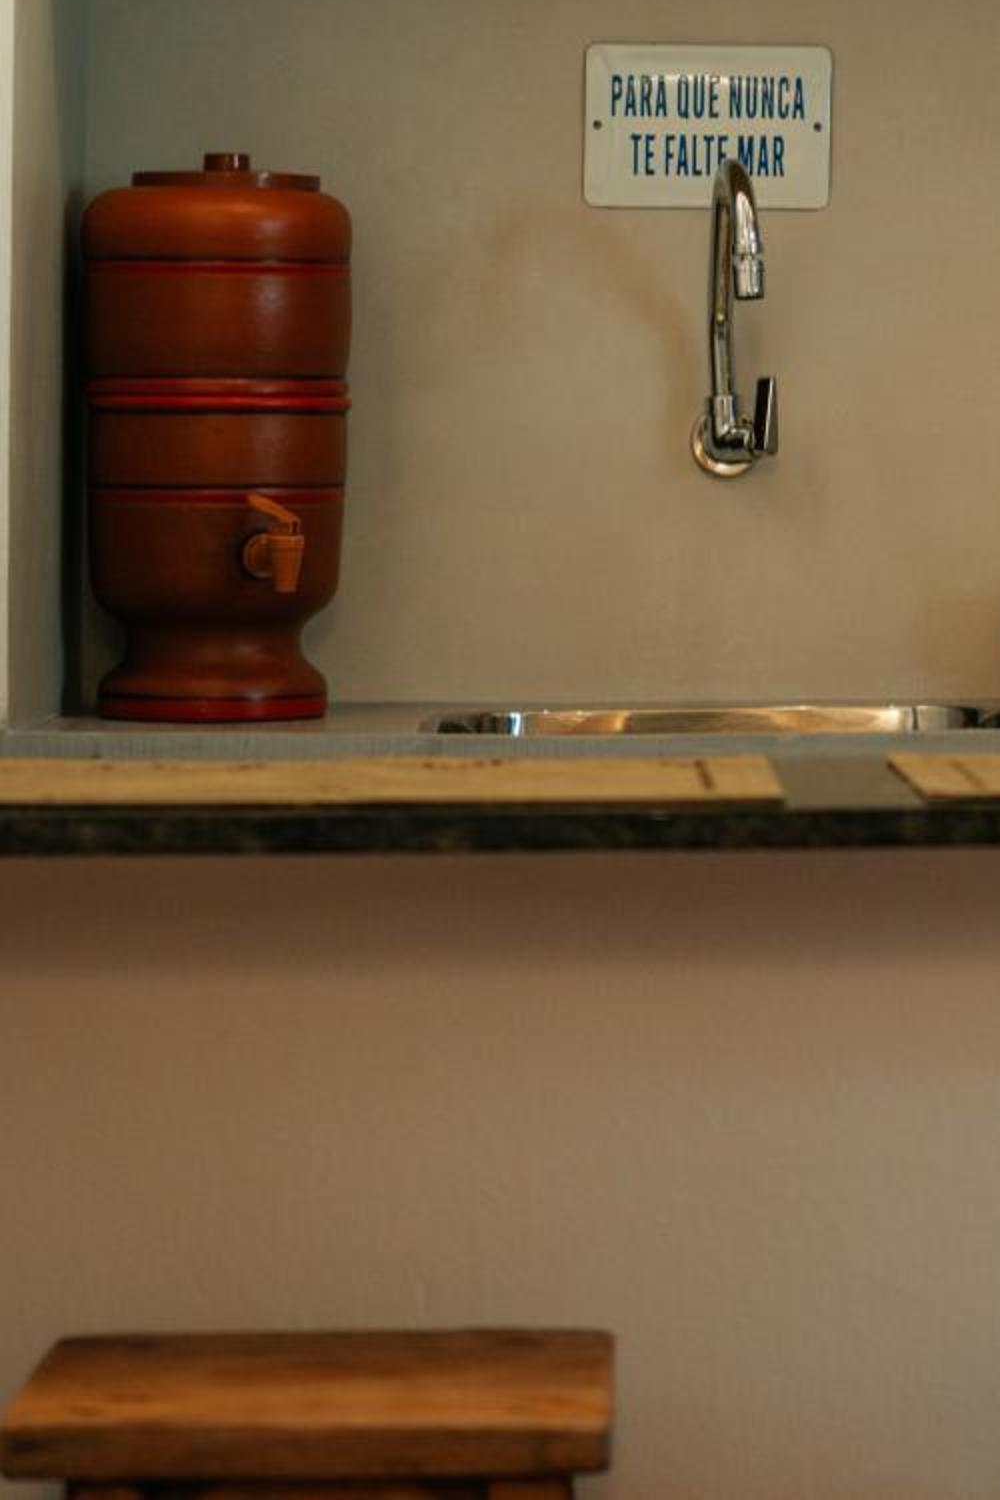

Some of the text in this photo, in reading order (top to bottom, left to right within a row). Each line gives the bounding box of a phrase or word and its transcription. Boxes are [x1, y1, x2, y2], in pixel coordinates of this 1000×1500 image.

[611, 74, 805, 119] PARA QUE NUNCA
[630, 133, 784, 177] TE FALTE MAR
